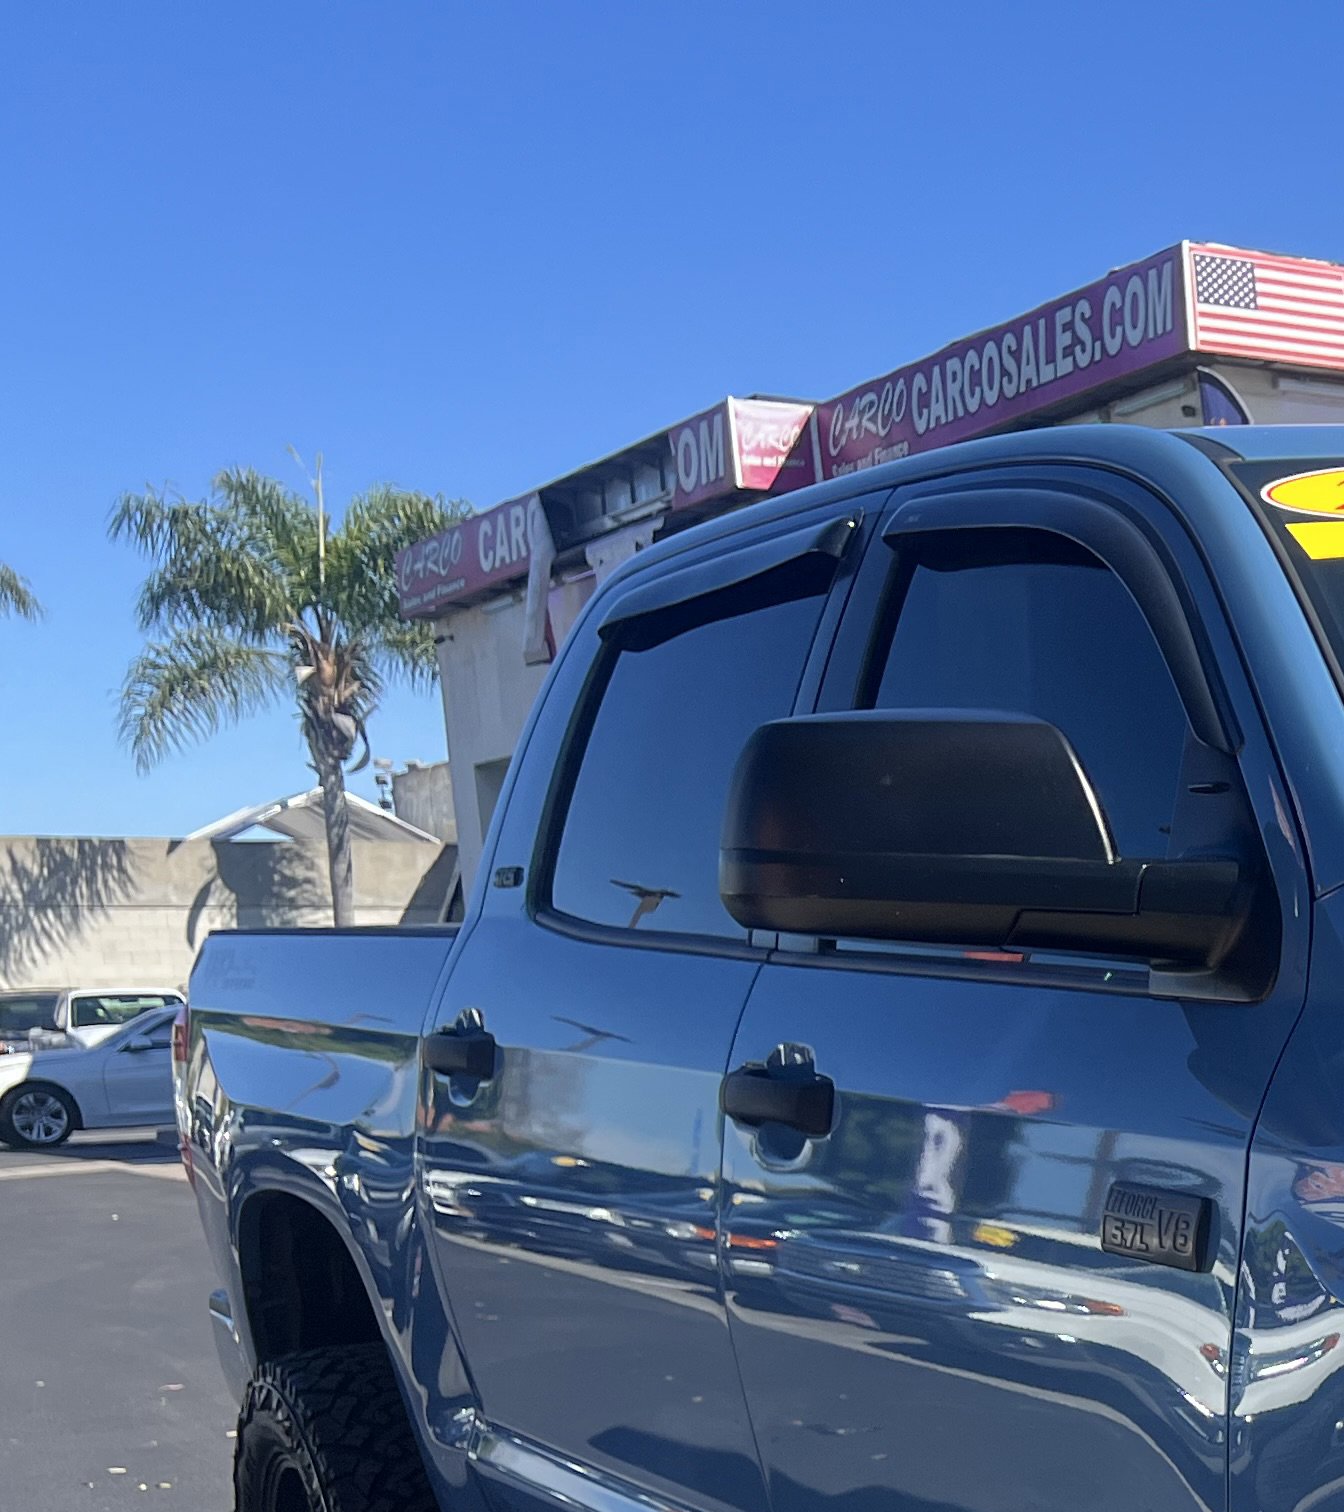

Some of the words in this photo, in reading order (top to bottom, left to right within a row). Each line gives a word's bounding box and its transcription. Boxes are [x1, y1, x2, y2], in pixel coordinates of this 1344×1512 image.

[829, 377, 907, 457] CARCO
[912, 260, 1173, 435] CARCOSALES.COM
[1157, 1208, 1192, 1256] V8
